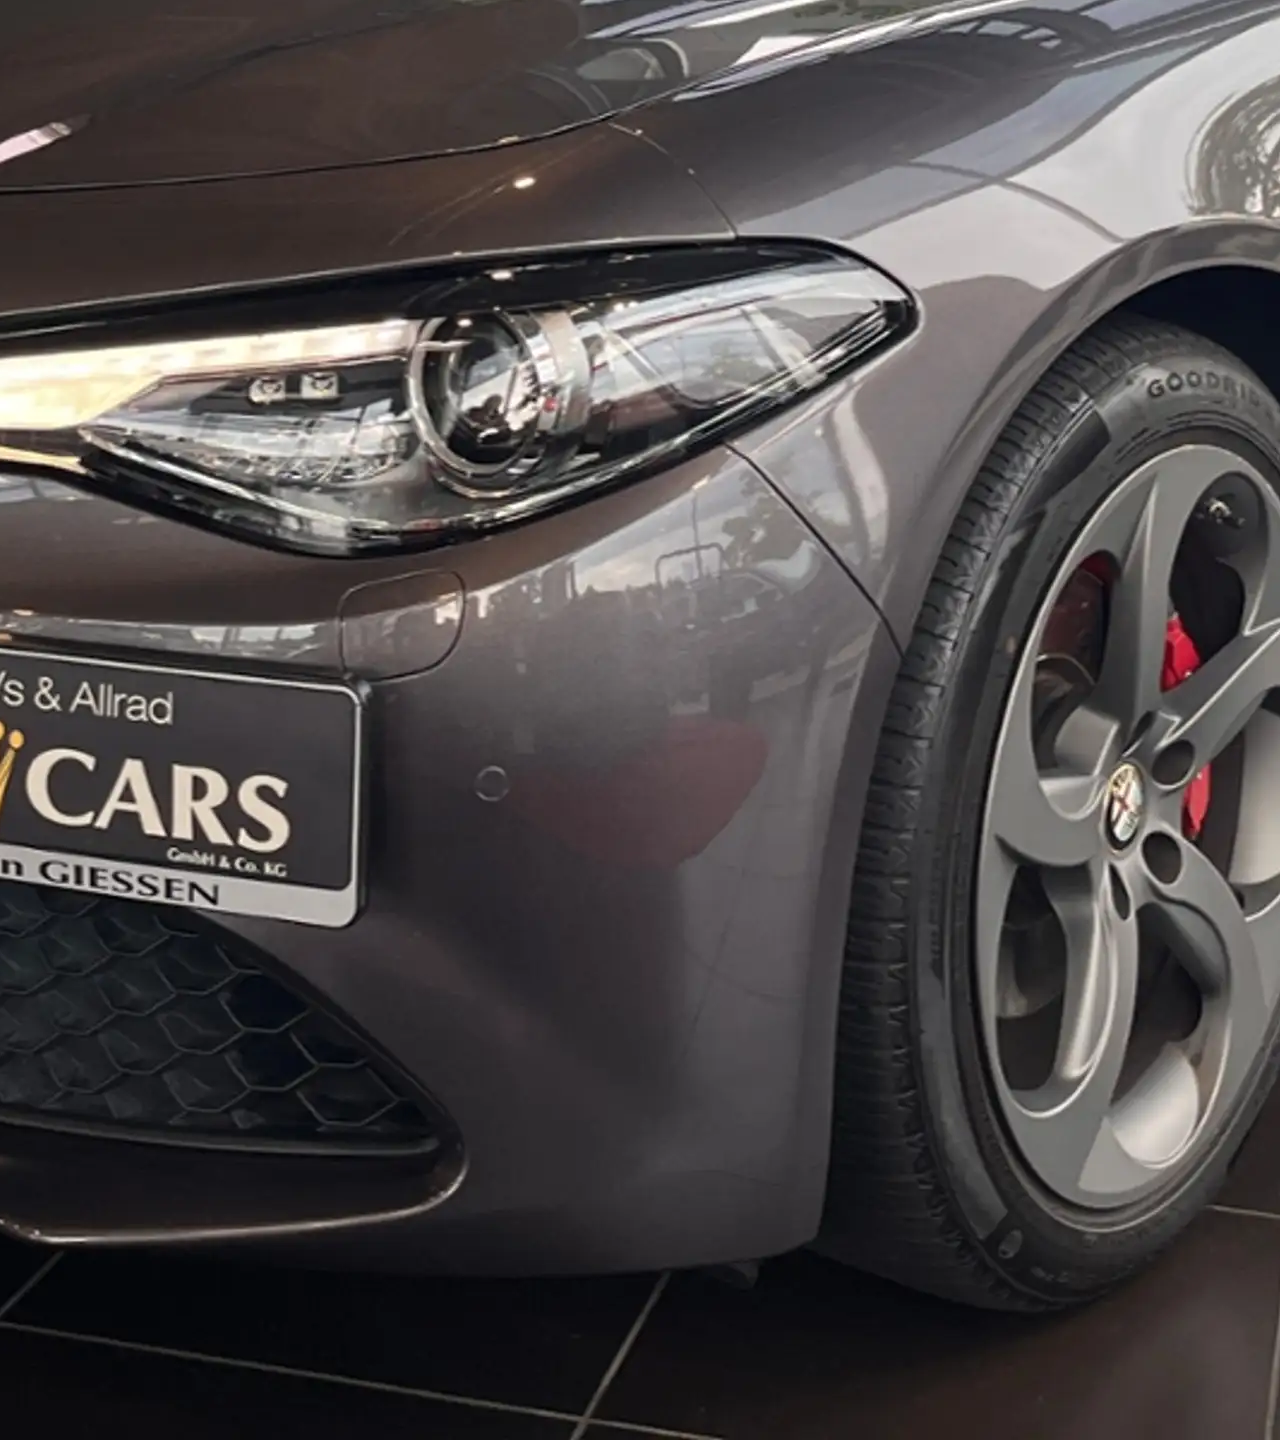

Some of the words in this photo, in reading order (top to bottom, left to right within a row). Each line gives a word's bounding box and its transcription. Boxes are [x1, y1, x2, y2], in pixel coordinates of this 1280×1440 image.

[35, 676, 61, 711] &
[70, 681, 174, 725] Allrad
[24, 747, 290, 853] CARS
[39, 860, 220, 906] GIESSEN
[167, 846, 217, 868] GmbH
[220, 854, 231, 869] &
[234, 856, 261, 874] Co.
[264, 861, 288, 877] KG
